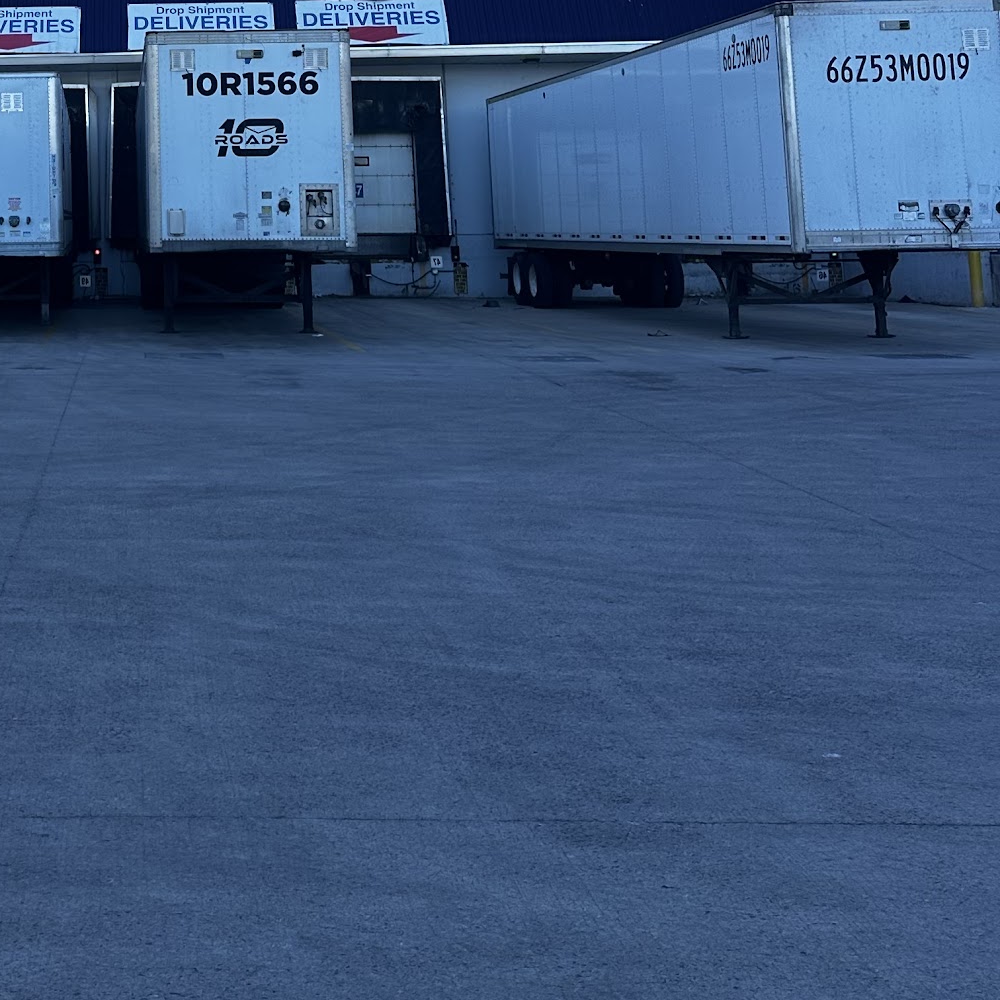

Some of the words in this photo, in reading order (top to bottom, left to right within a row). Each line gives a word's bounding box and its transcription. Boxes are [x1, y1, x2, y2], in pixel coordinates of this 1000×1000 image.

[156, 6, 185, 16] Drop
[188, 5, 245, 15] Shipment
[324, 3, 354, 12] Drop
[357, 1, 415, 12] Shipment
[134, 15, 269, 31] DELIVERIES
[302, 10, 441, 27] DELIVERIES
[722, 34, 770, 72] 66Z53M0019
[826, 52, 970, 83] 66Z53M0019
[181, 71, 319, 96] 10R1566
[214, 134, 289, 146] ROADS
